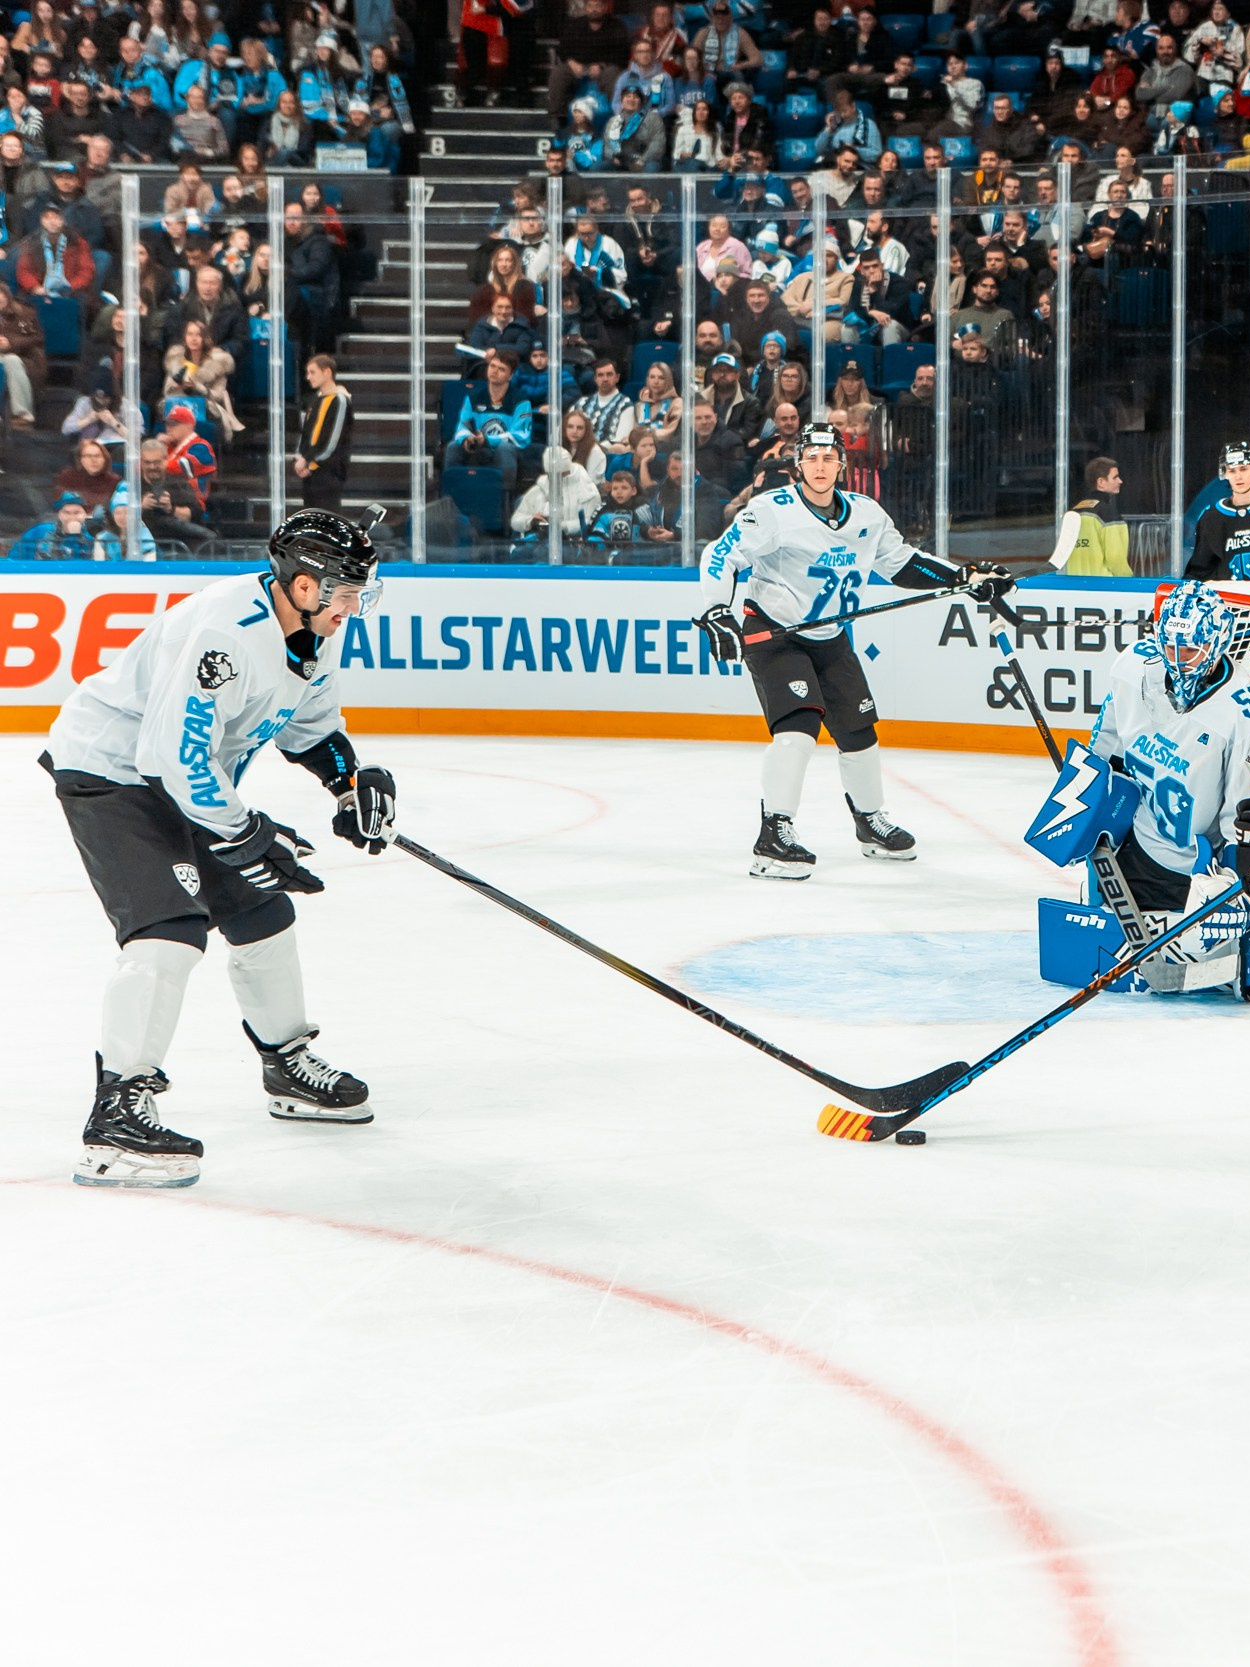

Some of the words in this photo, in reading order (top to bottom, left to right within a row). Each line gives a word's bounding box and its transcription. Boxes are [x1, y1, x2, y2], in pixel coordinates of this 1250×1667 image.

[431, 137, 446, 156] 8
[300, 556, 325, 570] CCM
[236, 599, 270, 627] 7
[802, 565, 863, 627] 76
[0, 593, 196, 689] BE
[986, 666, 1025, 710] &
